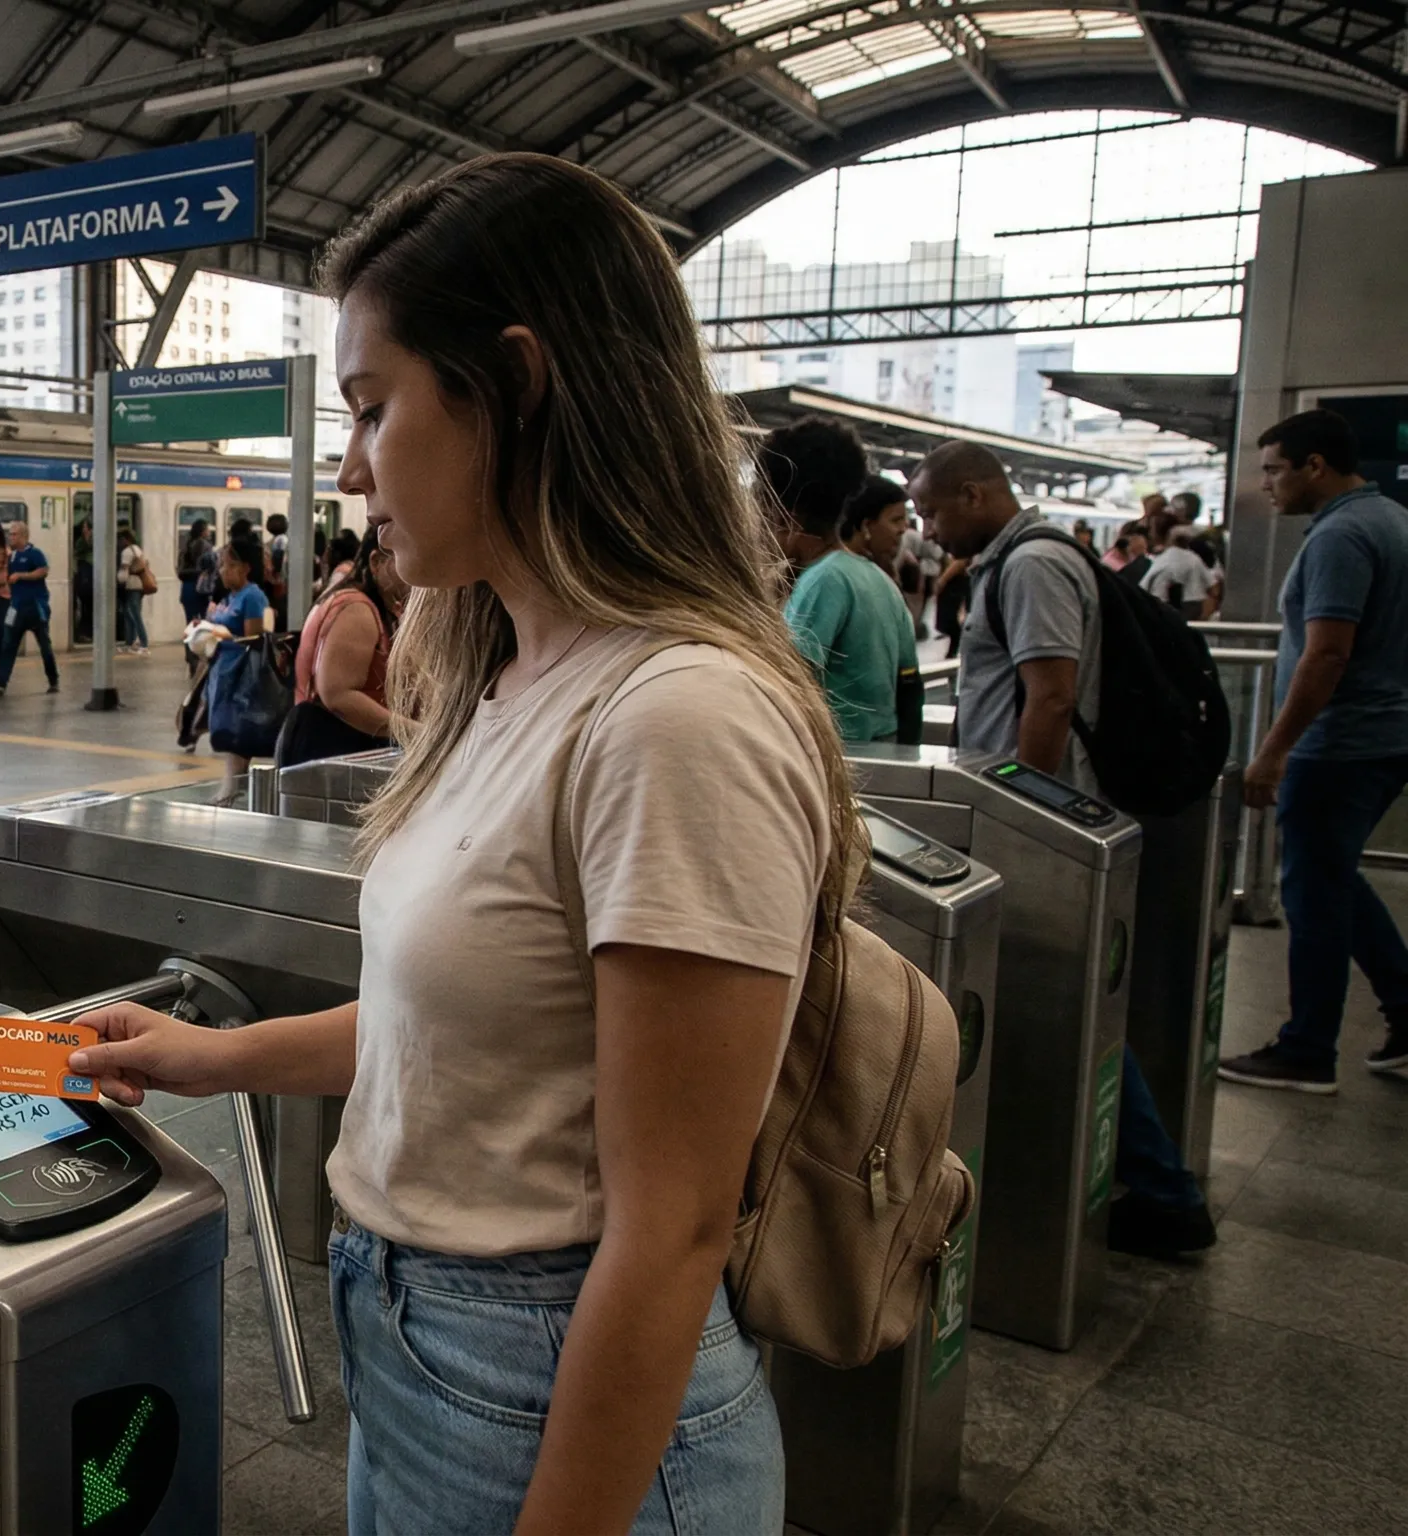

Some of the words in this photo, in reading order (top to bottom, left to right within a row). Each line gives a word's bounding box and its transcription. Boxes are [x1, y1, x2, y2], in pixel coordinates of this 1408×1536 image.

[174, 197, 190, 226] 2
[129, 372, 172, 389] ESTAÇÃO
[174, 371, 218, 385] CENTRAL
[219, 370, 235, 381] DO
[237, 367, 273, 380] BRASIL
[46, 1032, 80, 1046] MAIS
